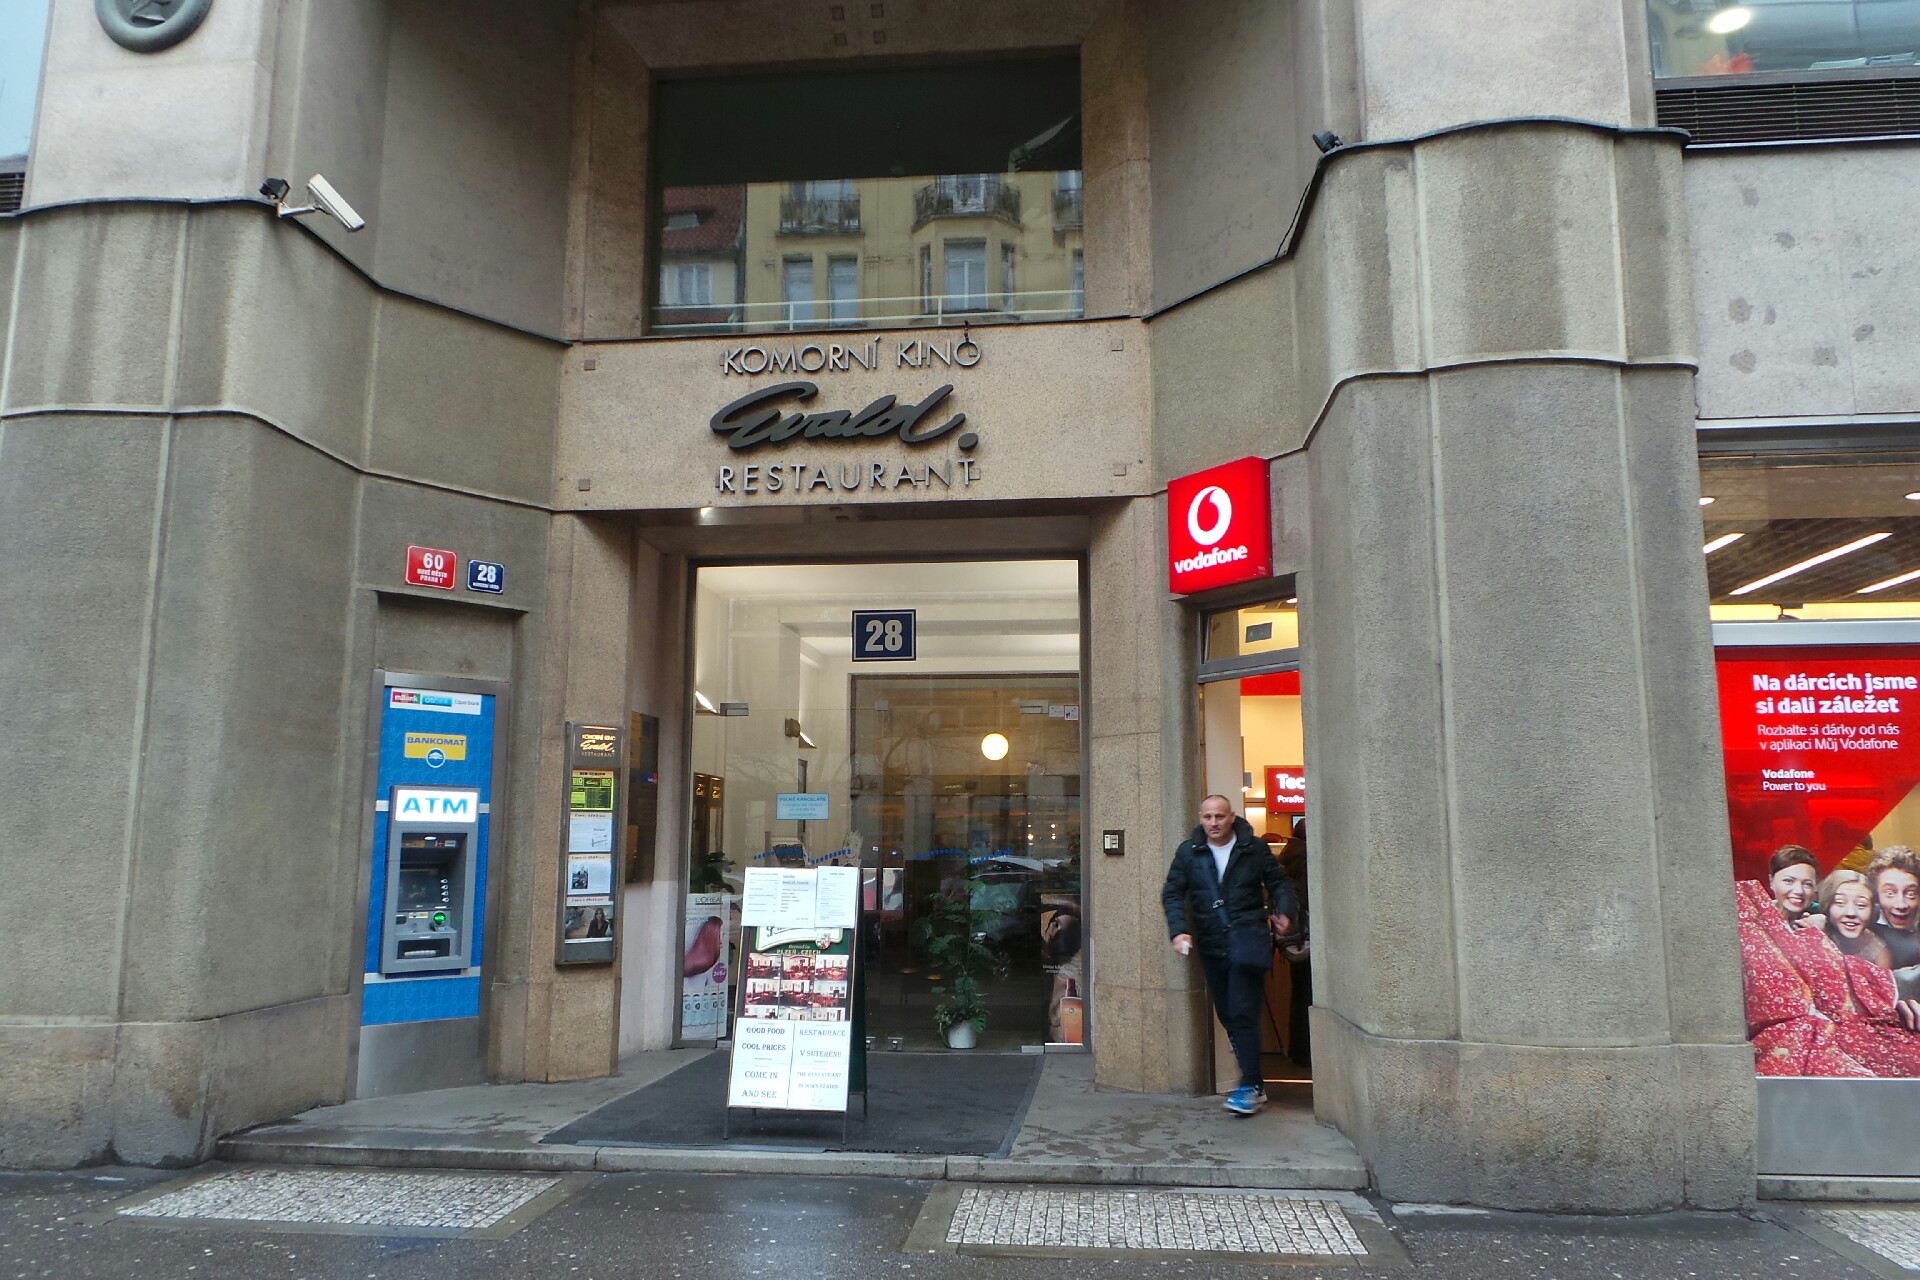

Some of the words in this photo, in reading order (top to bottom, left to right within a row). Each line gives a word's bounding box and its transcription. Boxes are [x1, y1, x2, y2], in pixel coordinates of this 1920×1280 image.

[723, 336, 881, 375] KOMORNÍ
[896, 338, 982, 368] KINO
[718, 459, 975, 494] RESTAURANT
[423, 552, 444, 570] 60
[1174, 545, 1248, 574] vodafone
[420, 574, 439, 583] PRAHA
[477, 564, 497, 583] 28
[865, 619, 903, 652] 28
[1753, 674, 1781, 691] Na
[1784, 673, 1862, 691] dárcích
[1865, 673, 1918, 694] jsme
[394, 694, 419, 703] mBank
[1756, 697, 1774, 714] si
[1778, 697, 1816, 714] dali
[1819, 695, 1900, 714] záležet
[1757, 724, 1807, 736] Rozbalte
[1809, 724, 1819, 735] si
[1822, 723, 1856, 738] dárky
[1859, 724, 1876, 735] od
[1878, 723, 1900, 735] nás
[406, 736, 466, 746] BANKOMAT
[1760, 741, 1768, 750] v
[1770, 739, 1812, 753] aplikaci
[1814, 737, 1839, 752] Můj
[1840, 738, 1898, 750] Vodafone
[1762, 769, 1815, 779] Vodafone
[1762, 782, 1795, 791] Power
[1795, 782, 1805, 791] to
[1806, 783, 1826, 792] you
[402, 797, 469, 814] ATM
[746, 1026, 766, 1034] GOOD
[767, 1027, 785, 1035] FOOD
[799, 1029, 846, 1037] RESTAURACE
[742, 1042, 760, 1050] COOL
[762, 1043, 787, 1051] PRICES
[800, 1049, 806, 1057] V
[744, 1070, 768, 1079] COME
[769, 1071, 778, 1079] IN
[741, 1089, 760, 1098] AND
[760, 1090, 777, 1099] SEE
